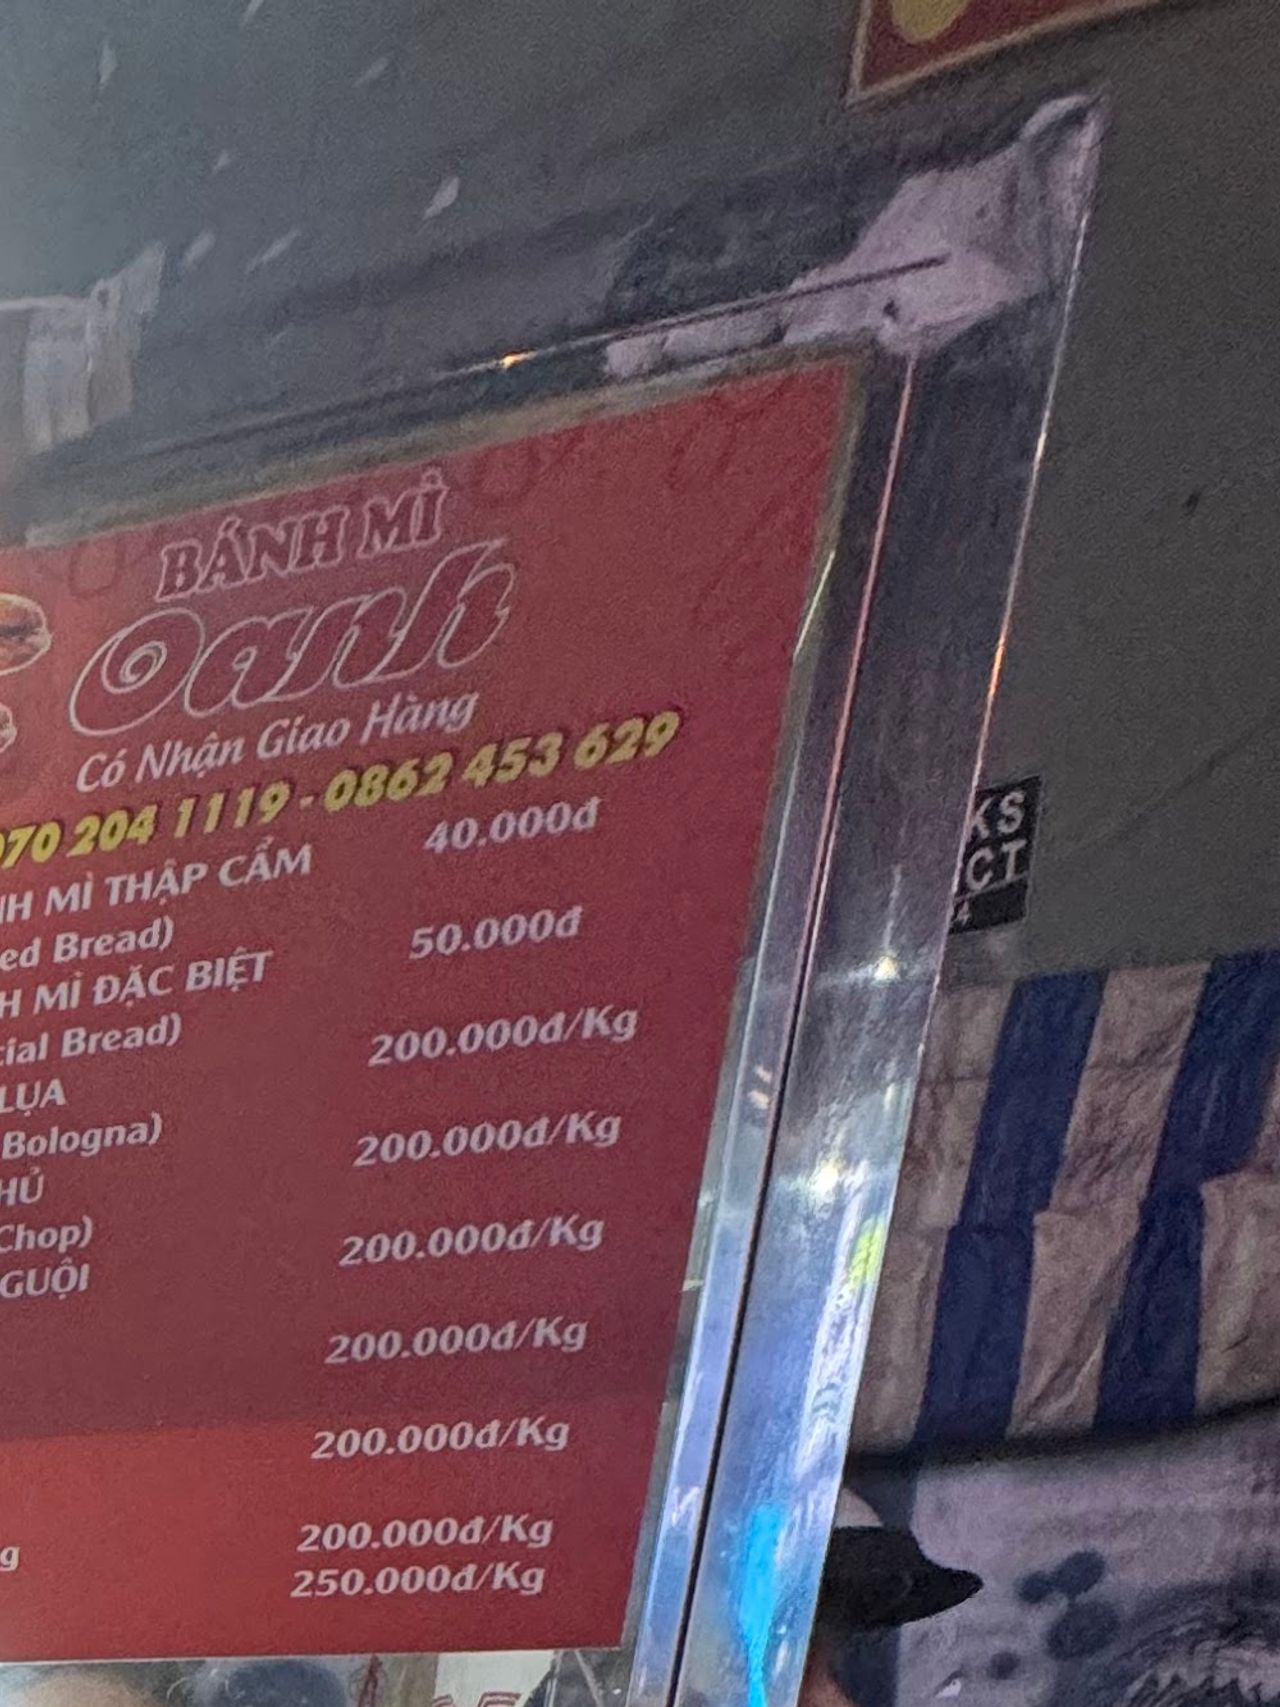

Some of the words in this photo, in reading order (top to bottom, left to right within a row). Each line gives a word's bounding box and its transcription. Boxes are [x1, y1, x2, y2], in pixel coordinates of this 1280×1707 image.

[156, 516, 349, 600] BÁNH
[356, 468, 448, 559] MÌ
[69, 539, 516, 736] Oanh
[76, 747, 126, 792] Có
[136, 732, 245, 785] Nhận
[256, 714, 351, 759] Giao
[360, 690, 480, 745] Hàng
[65, 805, 157, 857] 204
[175, 780, 292, 839] 1119
[324, 751, 455, 813] 0862
[462, 731, 565, 788] 453
[573, 710, 682, 770] 629
[424, 795, 602, 855] 40.000đ
[44, 877, 94, 917] MÌ
[105, 858, 208, 907] THẬP
[218, 835, 313, 887] CẨM
[54, 915, 175, 966] Bread)
[409, 904, 584, 960] 50.000đ
[33, 970, 81, 1015] MÌ
[93, 965, 176, 1008] ĐẶC
[185, 946, 274, 994] BIỆT
[60, 1012, 182, 1059] Bread)
[368, 1004, 638, 1067] 200.000đ/Kg
[2, 1111, 163, 1161] Bologna)
[352, 1110, 622, 1167] 200.000đ/Kg
[338, 1213, 605, 1267] 200.000đ/Kg
[324, 1315, 589, 1365] 200.000đ/Kg
[310, 1415, 570, 1460] 200.000đ/Kg
[296, 1513, 554, 1553] 200.000đ/Kg
[290, 1561, 546, 1599] 250.000đ/Kg
